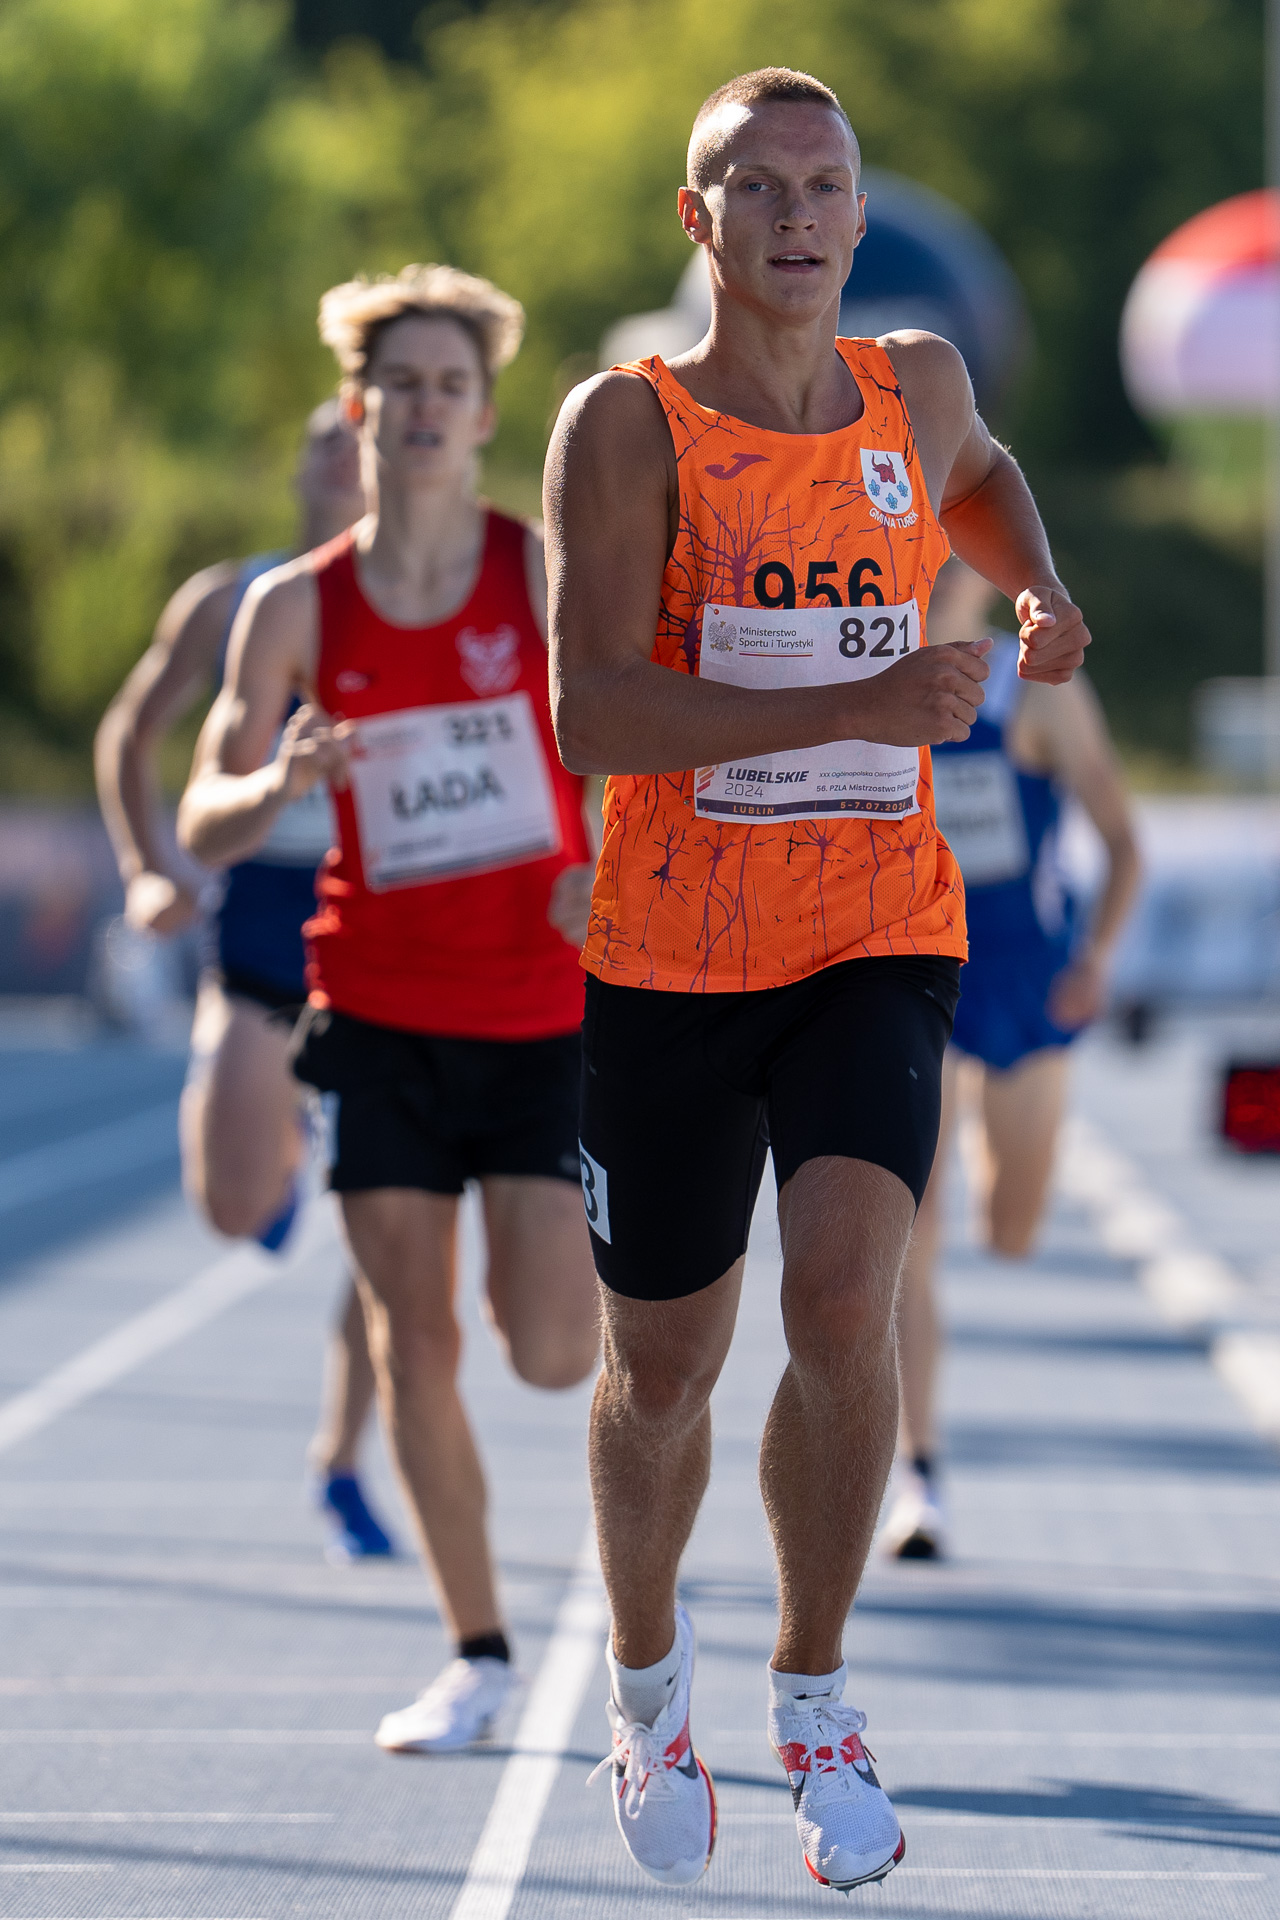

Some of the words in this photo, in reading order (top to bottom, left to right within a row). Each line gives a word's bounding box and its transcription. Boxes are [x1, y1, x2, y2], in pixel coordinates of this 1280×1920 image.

[869, 507, 896, 529] GMINA
[896, 508, 919, 529] TUREK
[753, 557, 885, 609] 956
[739, 626, 797, 638] Ministerstwo
[838, 613, 910, 659] 821
[738, 638, 769, 650] Sportu
[771, 640, 774, 648] i
[776, 638, 814, 650] Turystyki
[726, 767, 810, 784] LUBELSKIE
[831, 770, 873, 778] Ogólnopolska
[724, 782, 764, 798] 2024
[829, 784, 847, 792] PZLA
[848, 784, 896, 792] Mistrzostwa
[733, 804, 775, 815] LUBLIN
[840, 801, 906, 811] 5-7.07.2024
